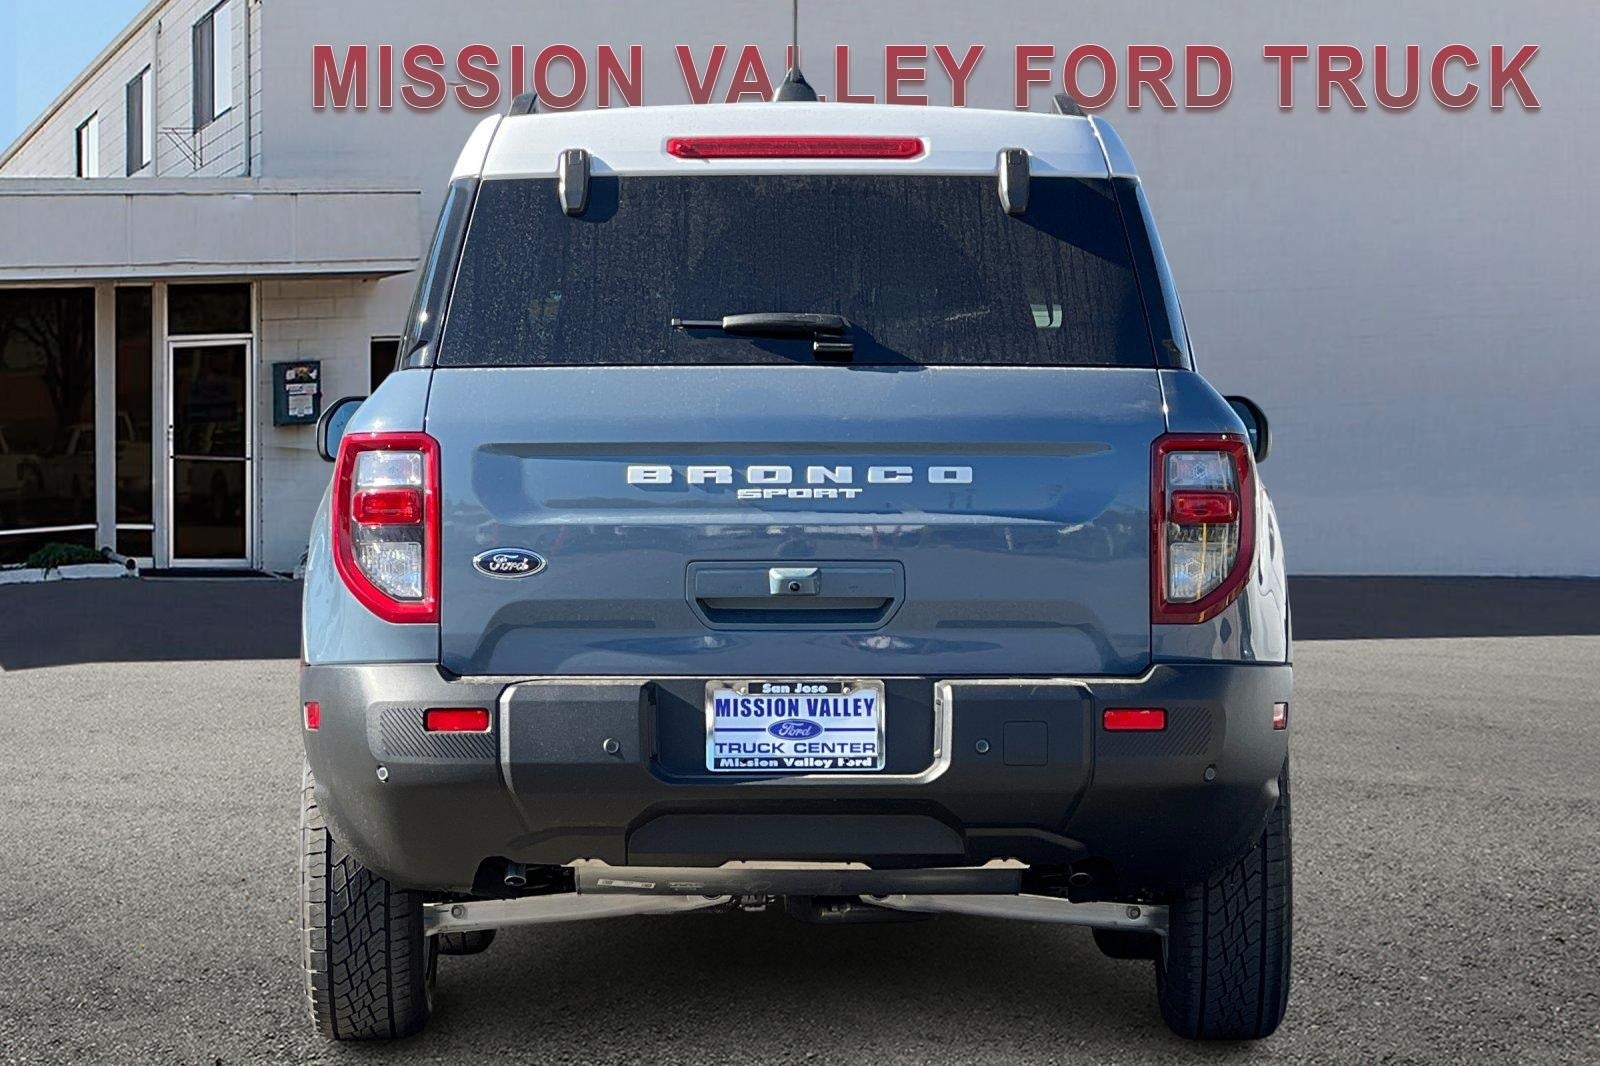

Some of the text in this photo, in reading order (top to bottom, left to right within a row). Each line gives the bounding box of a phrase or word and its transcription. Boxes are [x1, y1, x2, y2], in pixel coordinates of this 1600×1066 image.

[312, 44, 643, 109] MISSION
[1015, 44, 1233, 109] FORD
[1263, 44, 1541, 109] TRUCK
[627, 465, 973, 484] BRONCO
[737, 488, 862, 500] SPORT
[489, 553, 529, 571] Ford
[762, 683, 828, 694] San Jose
[715, 698, 875, 717] MISSION VALLEY
[778, 722, 812, 736] Ford
[715, 742, 876, 754] TRUCK CENTER
[783, 757, 833, 769] Valley
